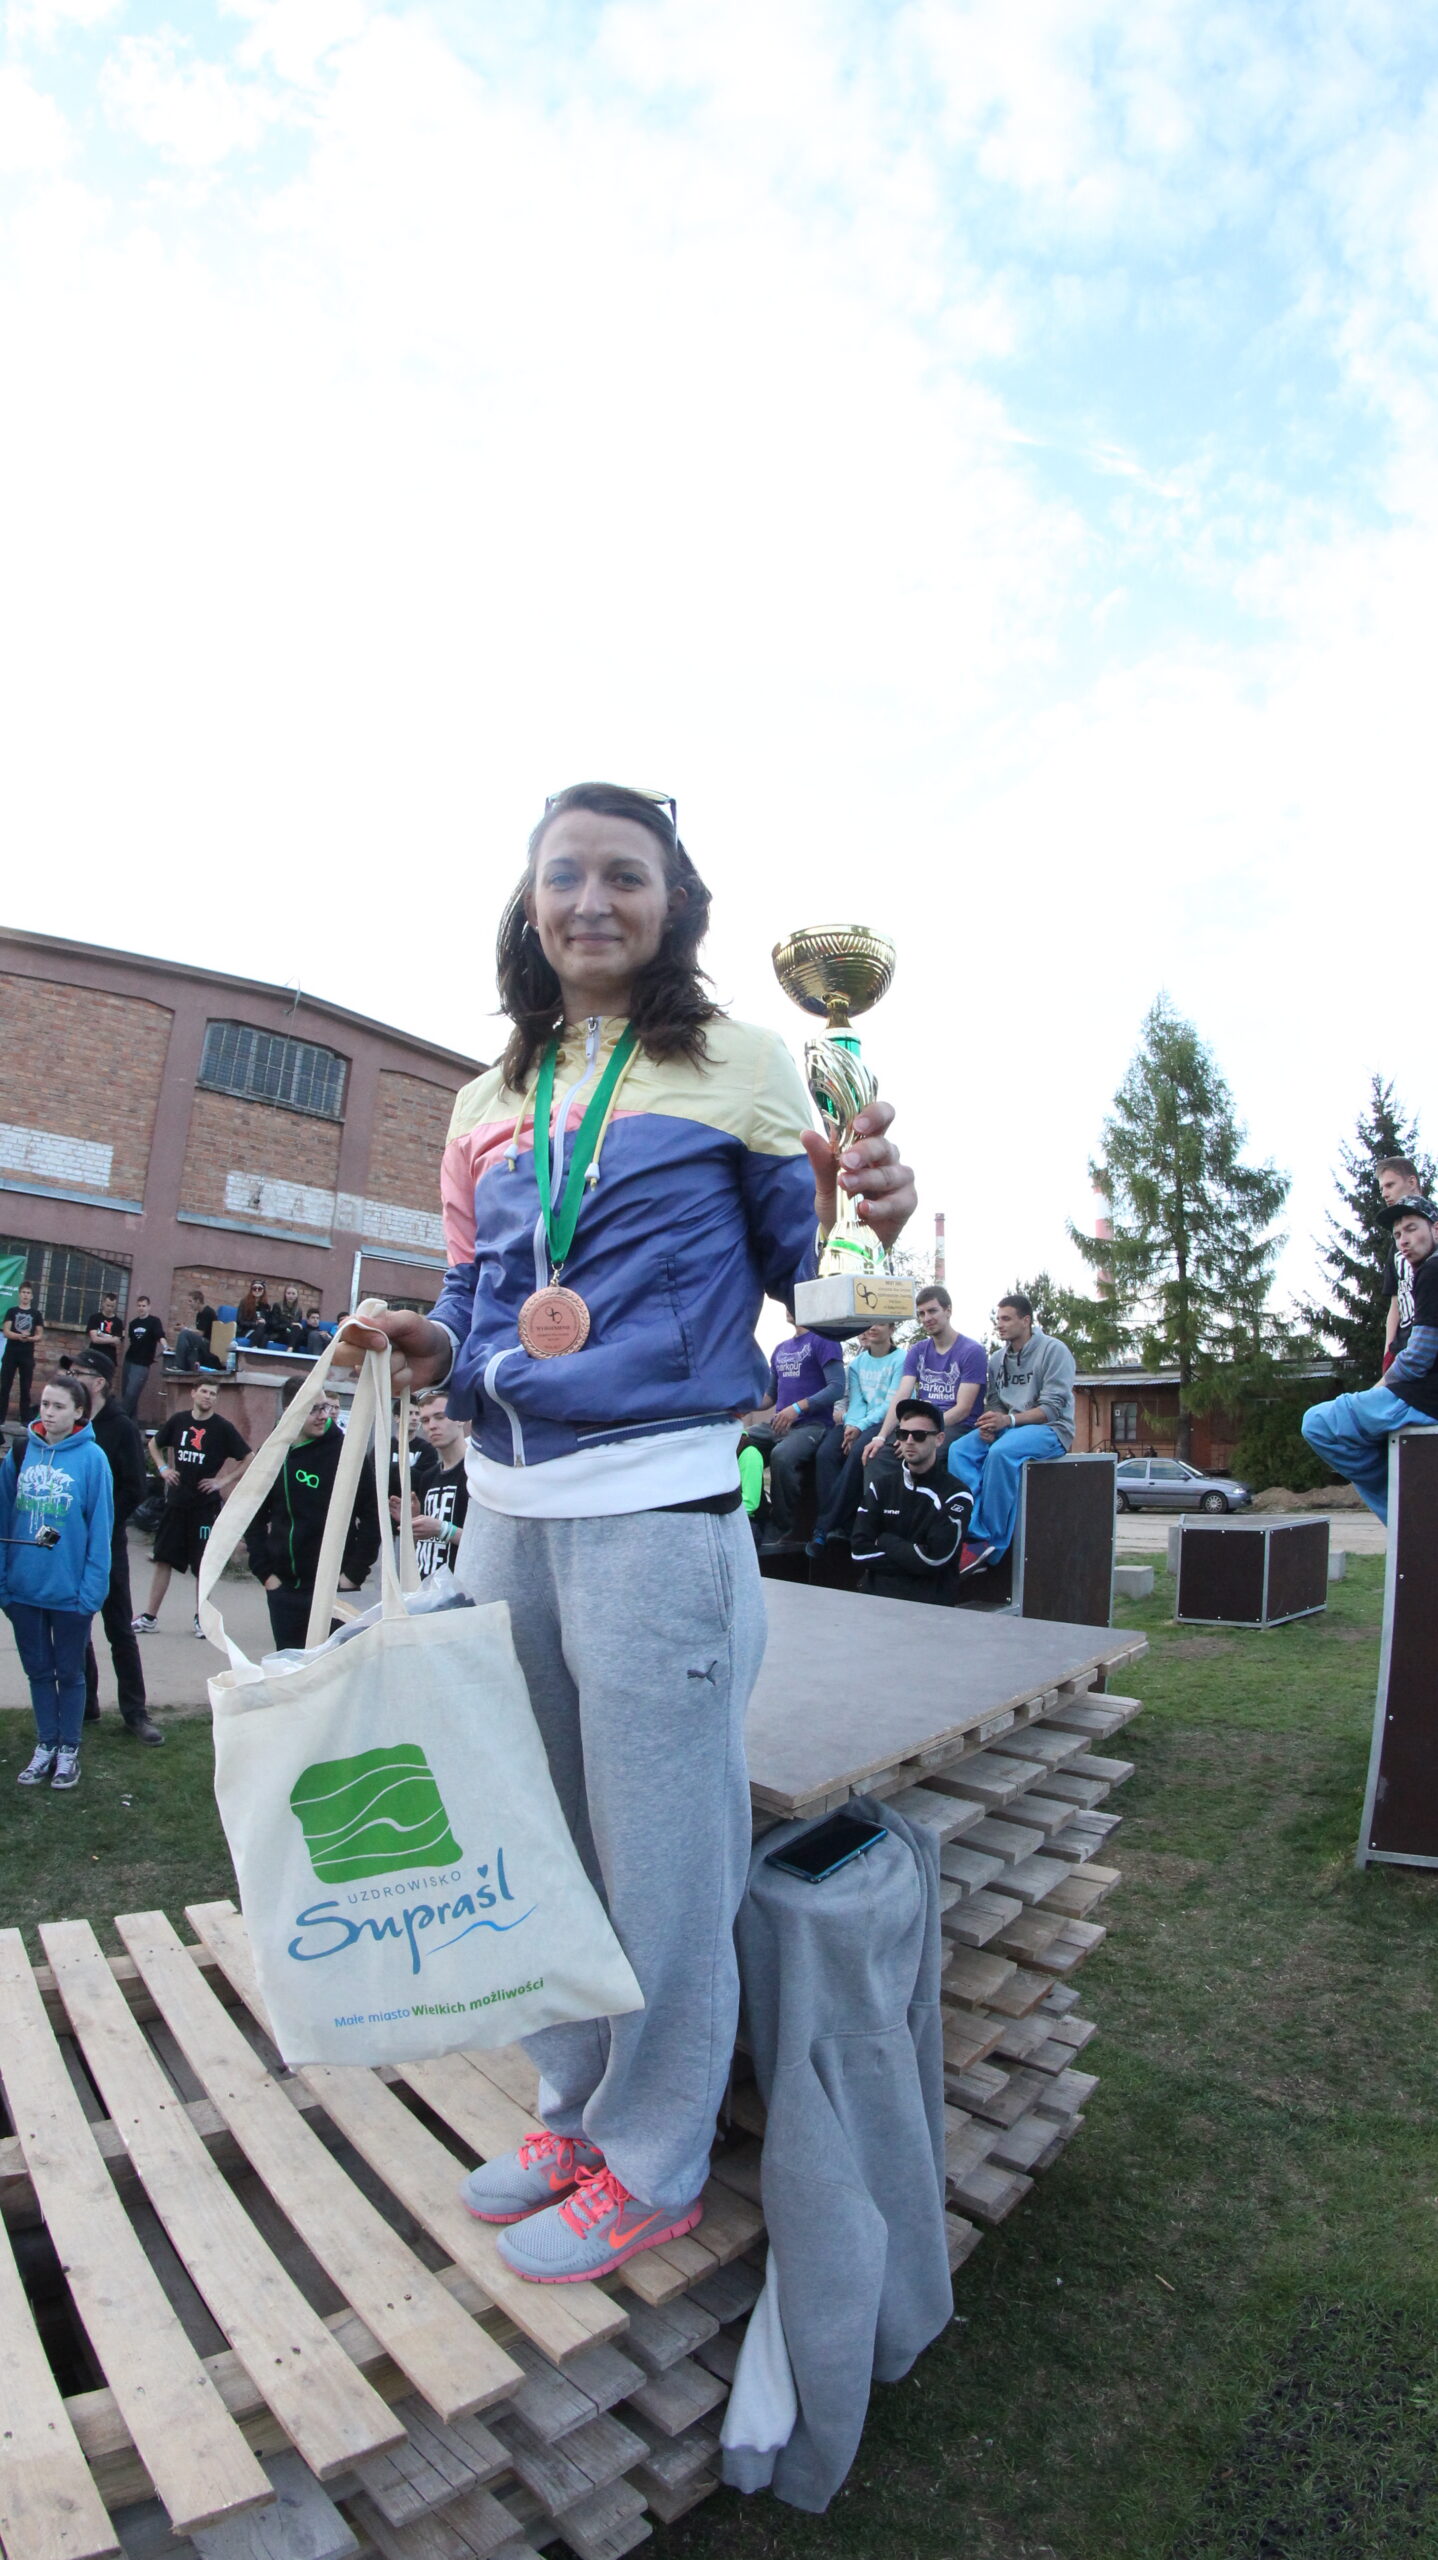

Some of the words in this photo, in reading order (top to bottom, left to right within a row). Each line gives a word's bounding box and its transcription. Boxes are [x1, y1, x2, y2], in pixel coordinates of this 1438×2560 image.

[928, 1392, 955, 1400] united
[178, 1450, 206, 1465] 3CITY
[347, 1870, 462, 1905] UZDROWISKO
[334, 2013, 365, 2028] Małe
[368, 2008, 410, 2024] miasto
[411, 2001, 466, 2017] Wielkich
[469, 1977, 545, 2010] możliwości
